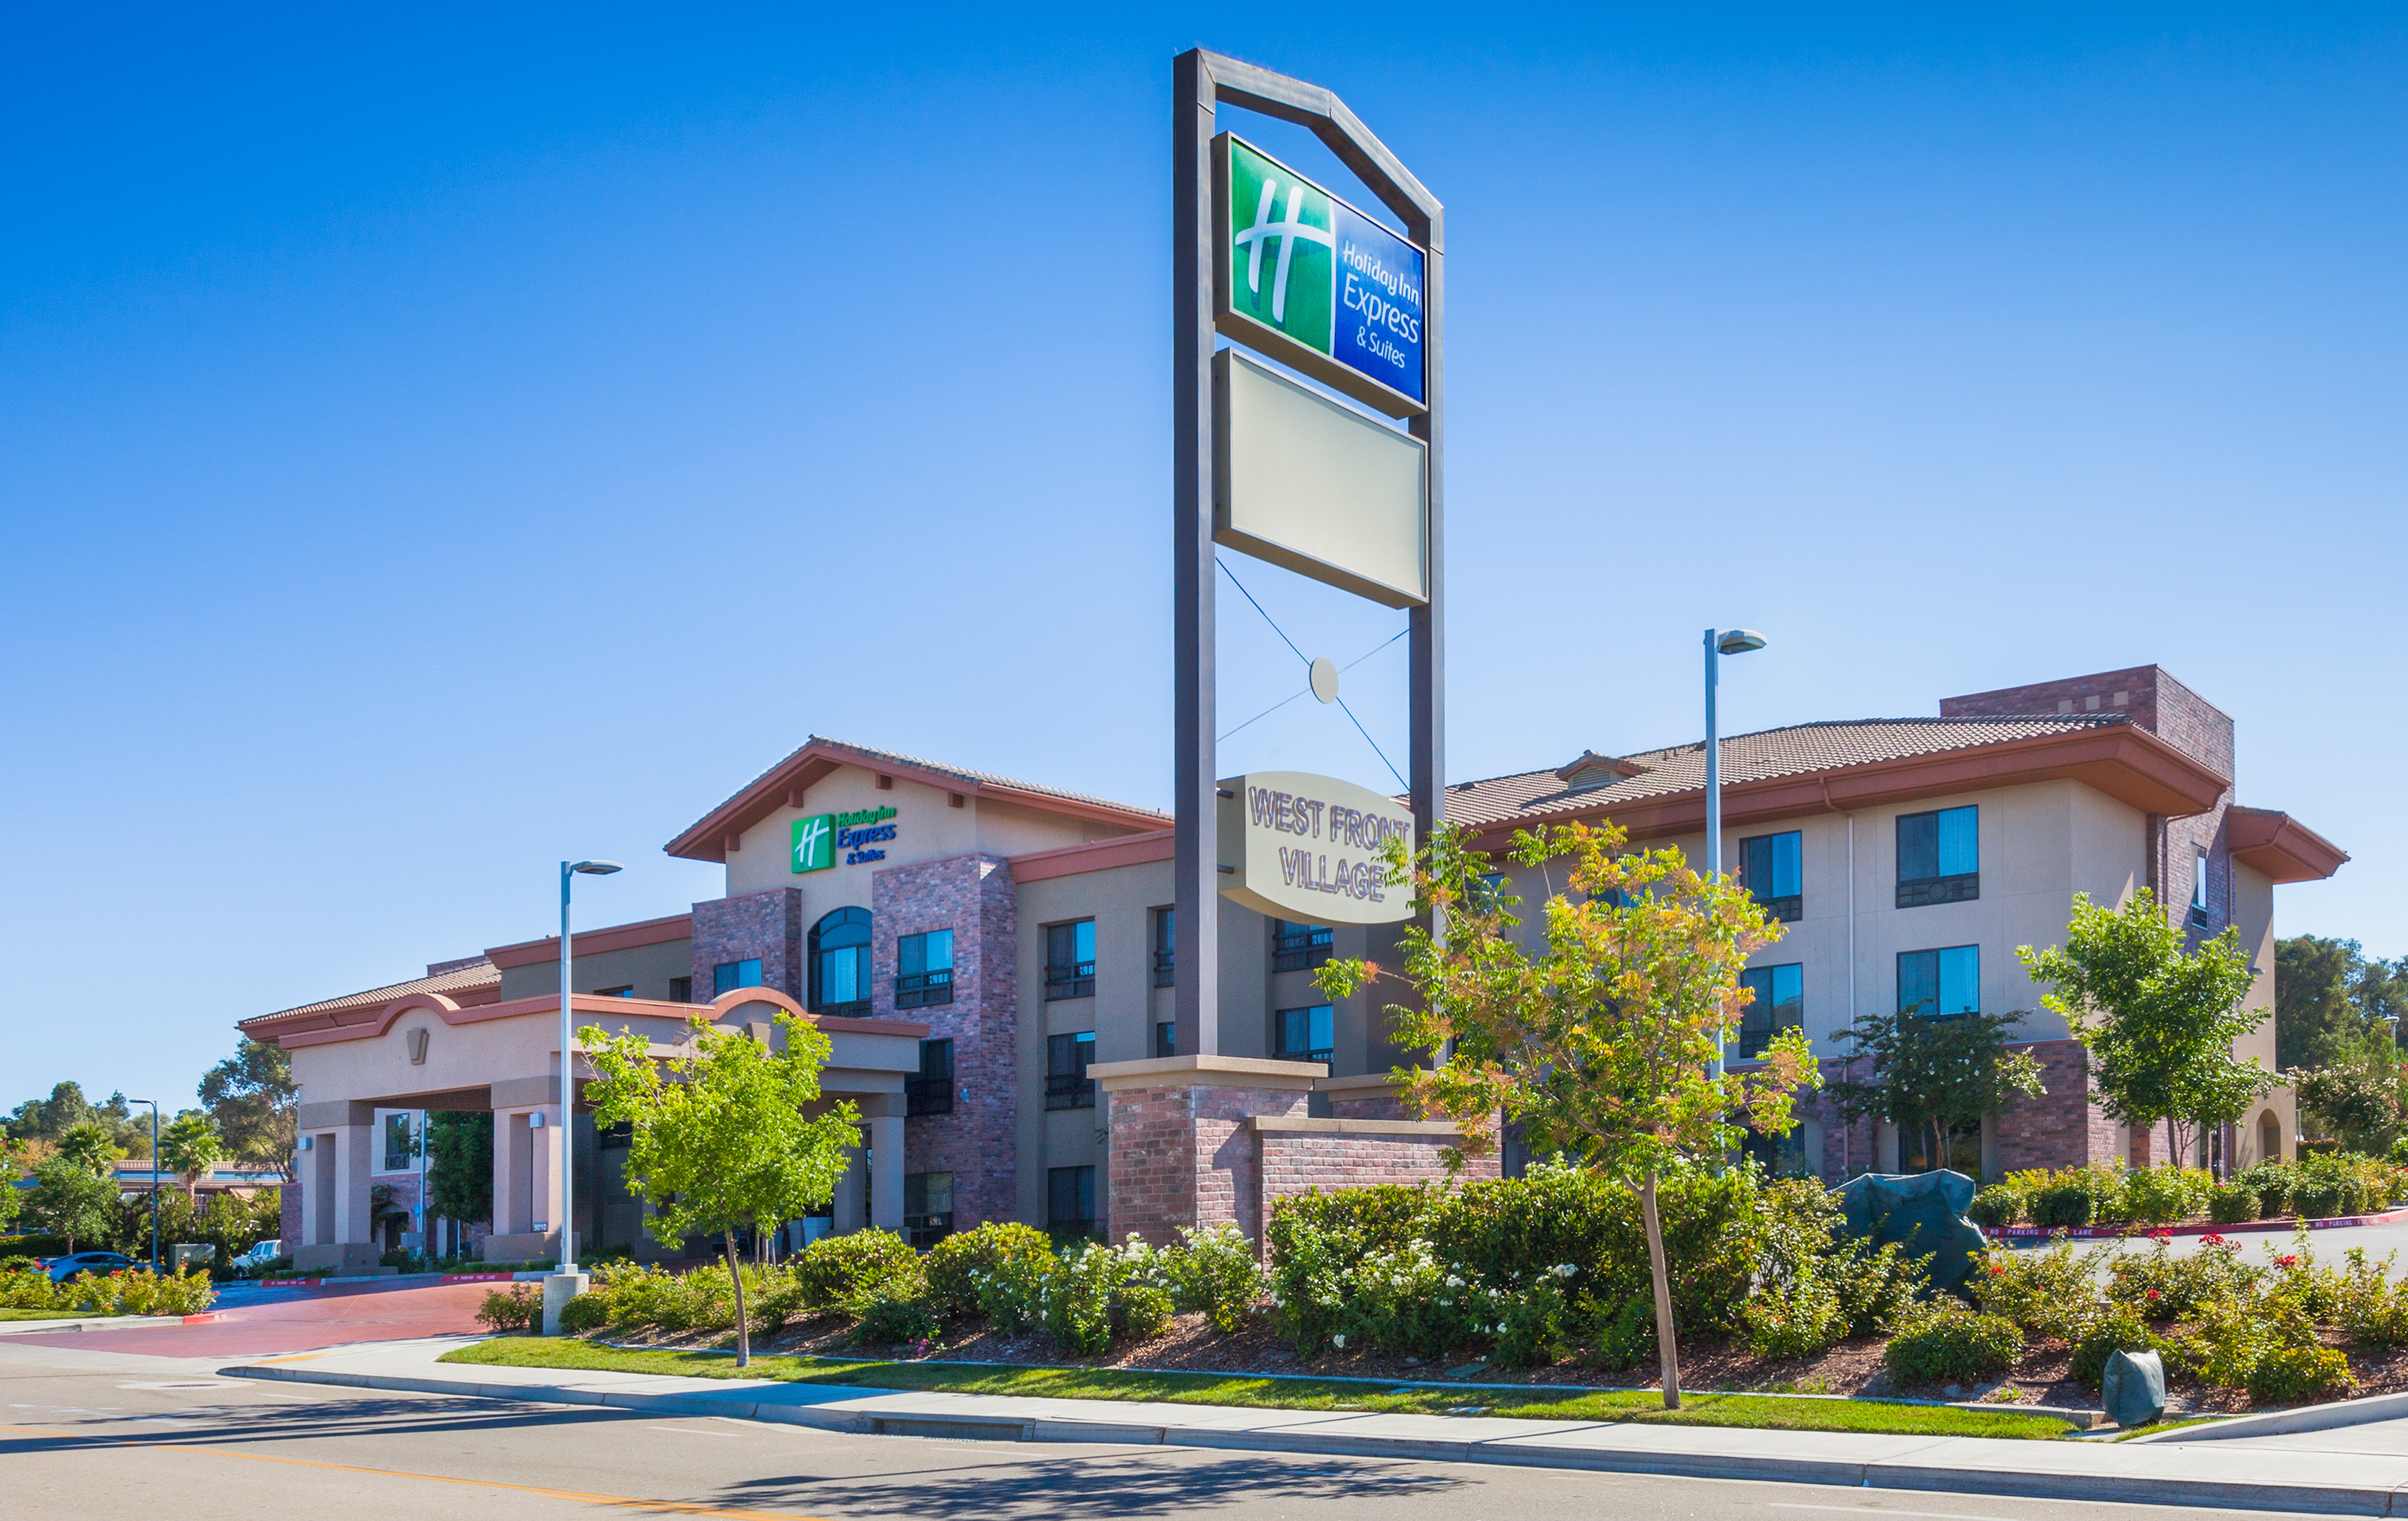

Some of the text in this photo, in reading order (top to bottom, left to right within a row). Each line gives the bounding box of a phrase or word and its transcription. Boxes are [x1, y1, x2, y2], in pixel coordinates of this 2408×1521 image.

[1343, 240, 1419, 306] Holiday Inn
[1343, 273, 1419, 343] Express
[1356, 325, 1405, 368] & Suites
[837, 805, 897, 827] Holiday Inn
[837, 824, 897, 850] Express
[1248, 786, 1410, 854] WEST FRONT
[846, 849, 886, 865] & Suites
[1279, 846, 1385, 902] VILLAGE
